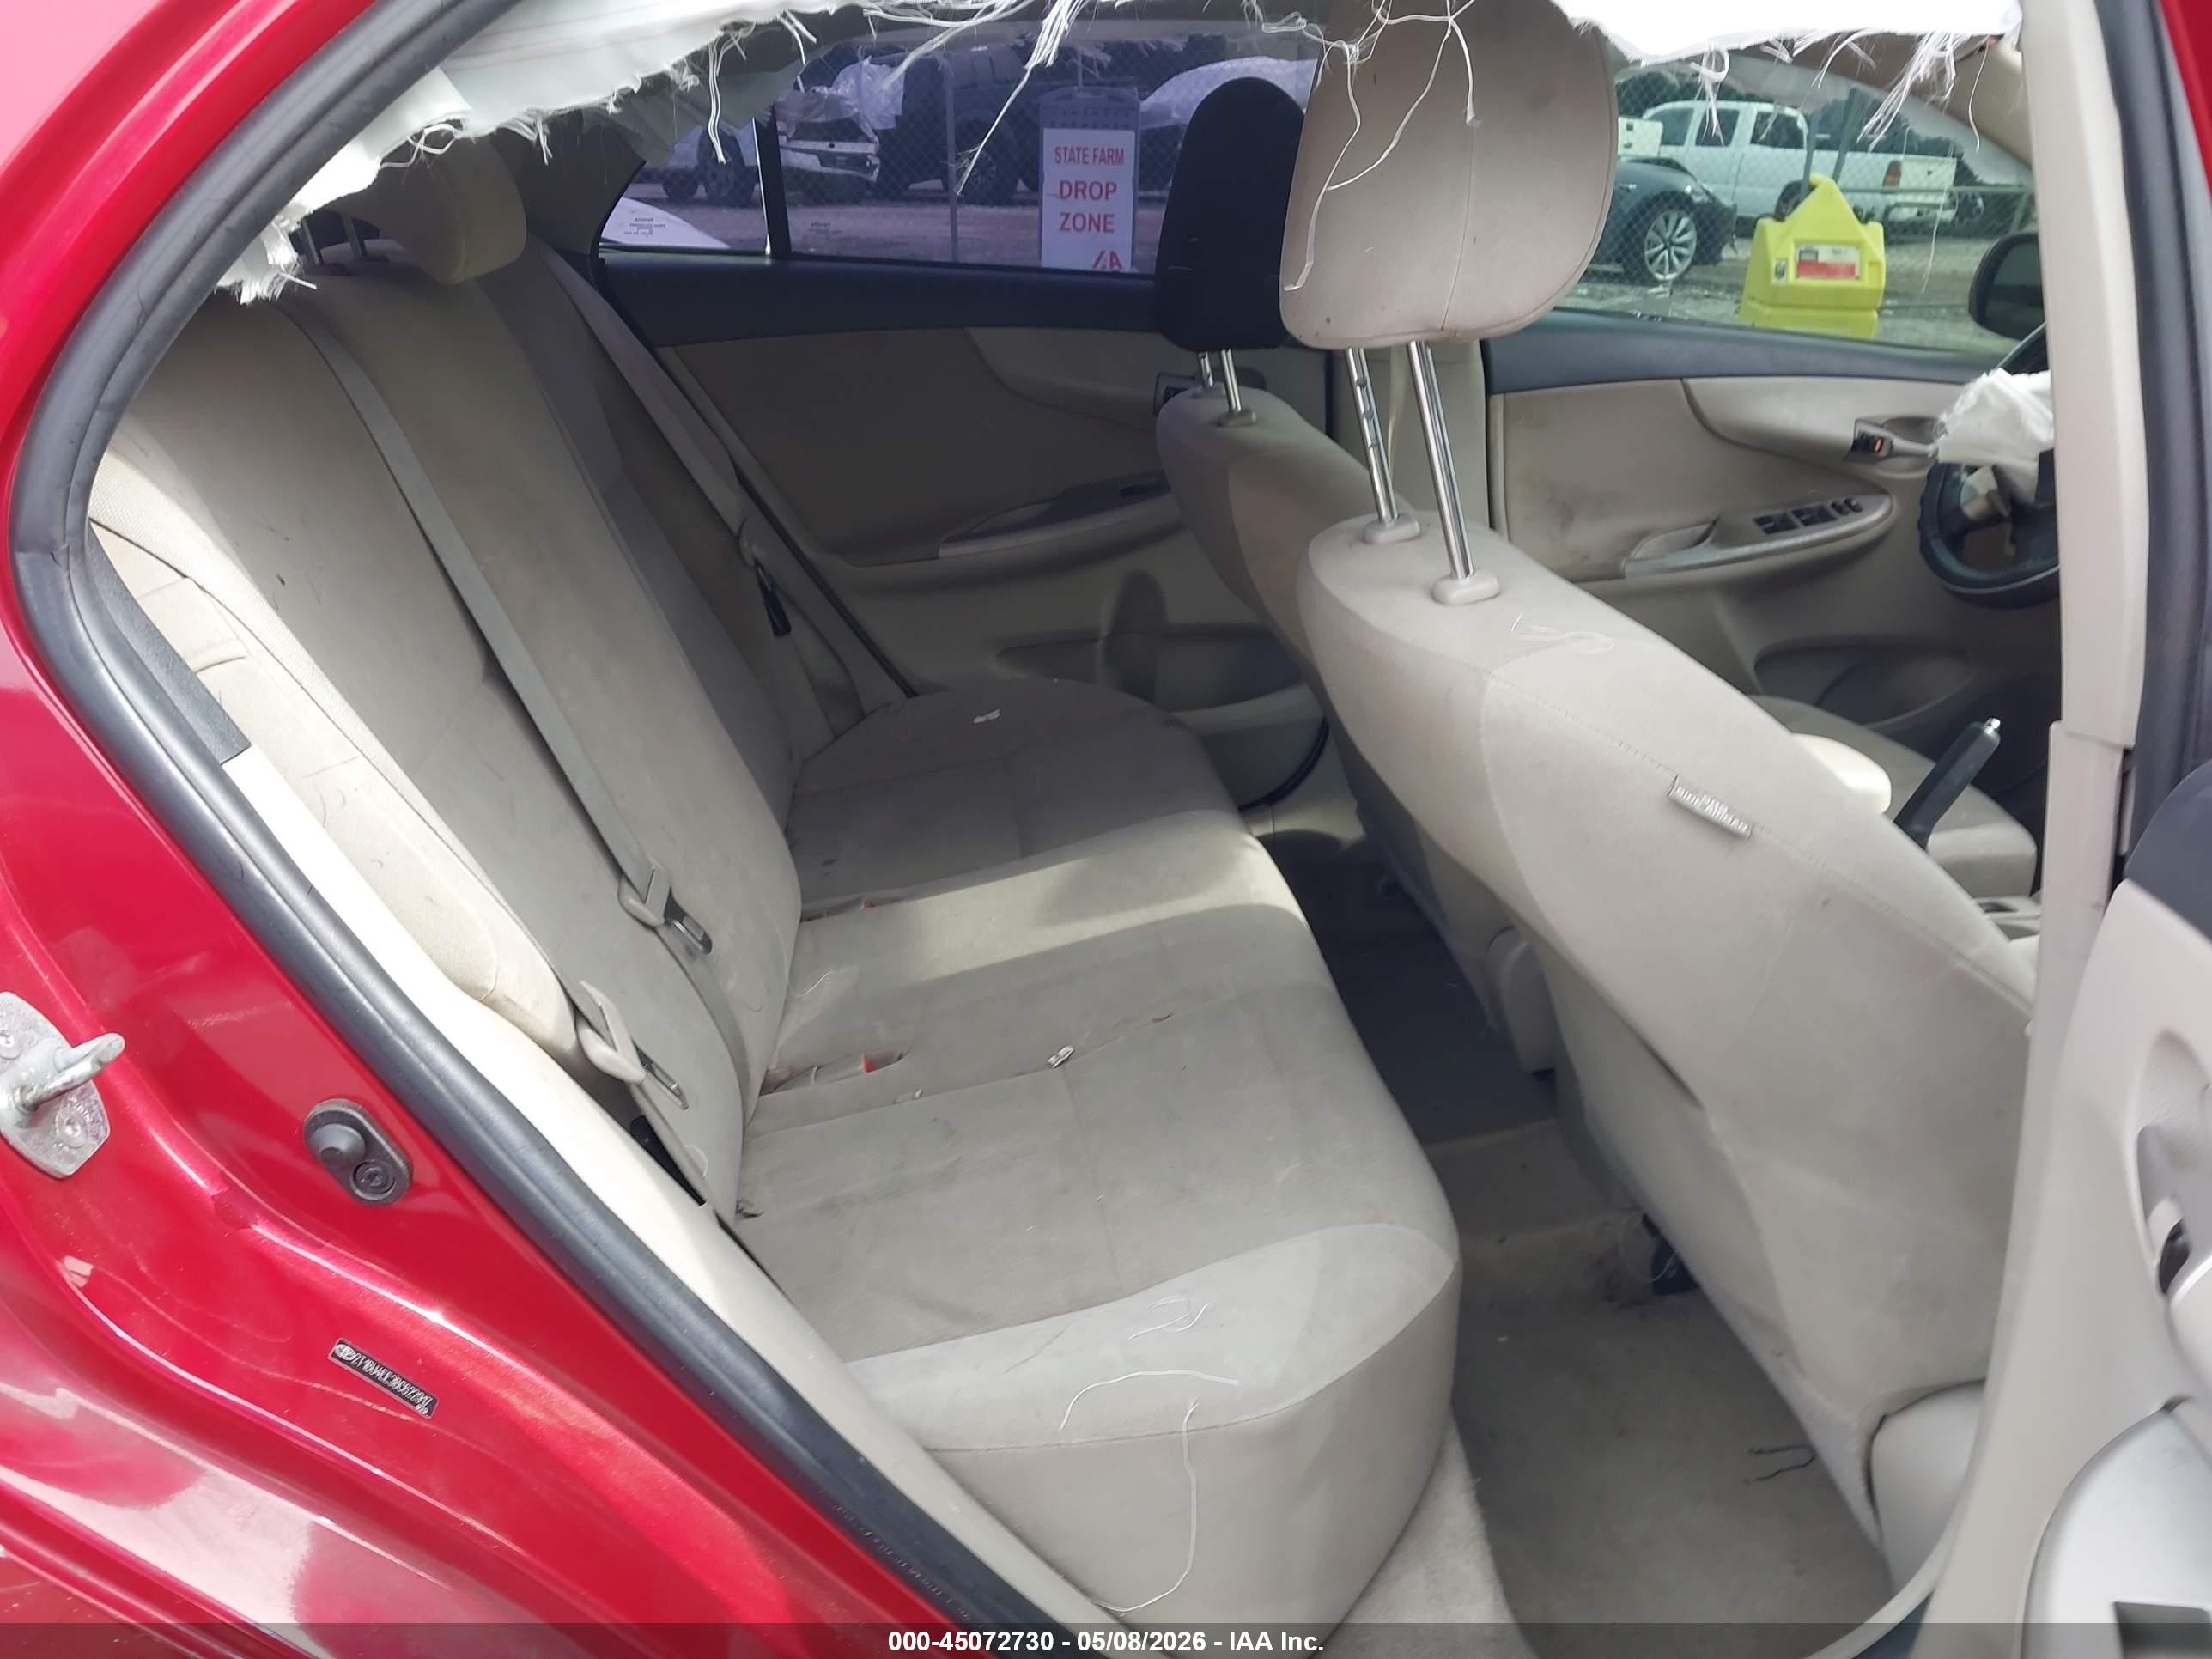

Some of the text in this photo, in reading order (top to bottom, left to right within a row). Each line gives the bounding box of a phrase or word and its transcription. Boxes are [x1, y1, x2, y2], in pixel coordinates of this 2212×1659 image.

[1054, 146, 1125, 166] STATE FARM
[1059, 179, 1117, 201] DROP
[1059, 213, 1115, 234] ZONE
